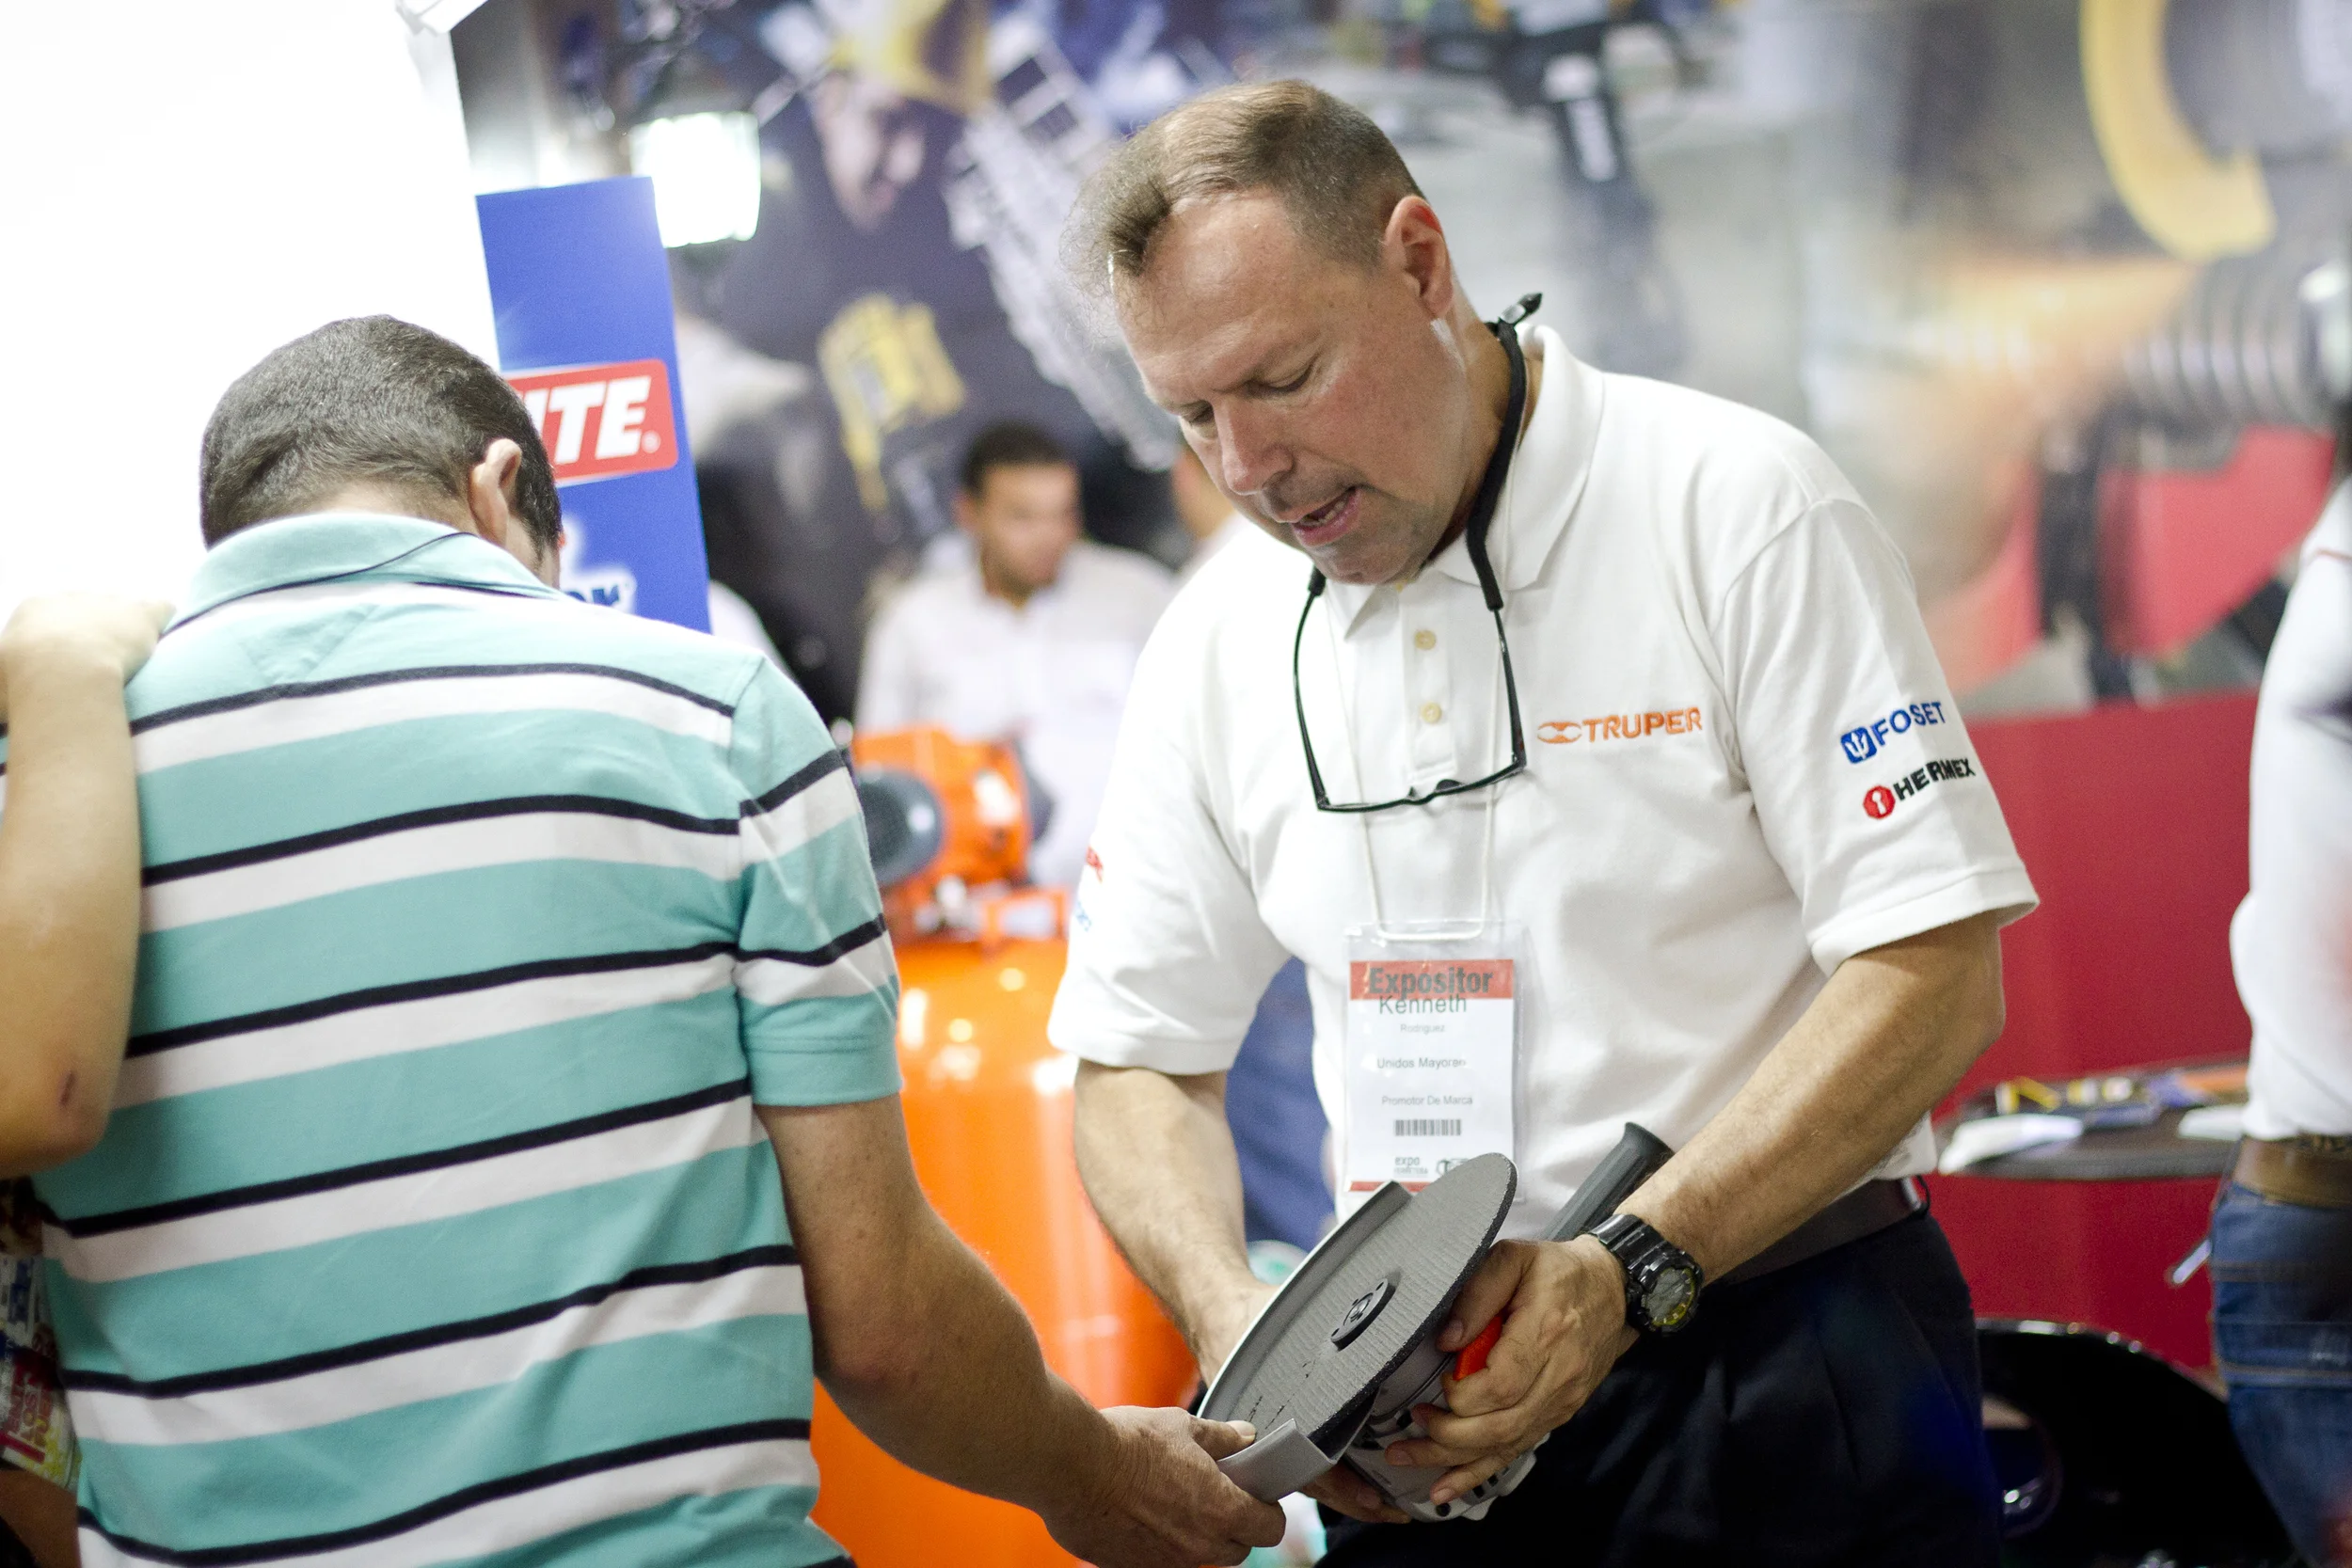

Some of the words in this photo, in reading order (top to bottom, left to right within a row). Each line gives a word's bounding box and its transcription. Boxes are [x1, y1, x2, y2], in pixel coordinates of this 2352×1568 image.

[518, 375, 651, 465] ITE
[1581, 706, 1703, 743] TRUPER
[1871, 701, 1946, 747] FOSET
[1893, 757, 1977, 800] HERMEX
[1368, 966, 1494, 999] Expositor
[1378, 995, 1468, 1015] Kenneth
[1400, 1023, 1446, 1036] Rodriguez
[1376, 1057, 1415, 1069] Unidos
[1381, 1096, 1424, 1106] Promotor
[1427, 1095, 1441, 1105] De
[1443, 1095, 1473, 1105] Marca
[1394, 1157, 1421, 1167] expo
